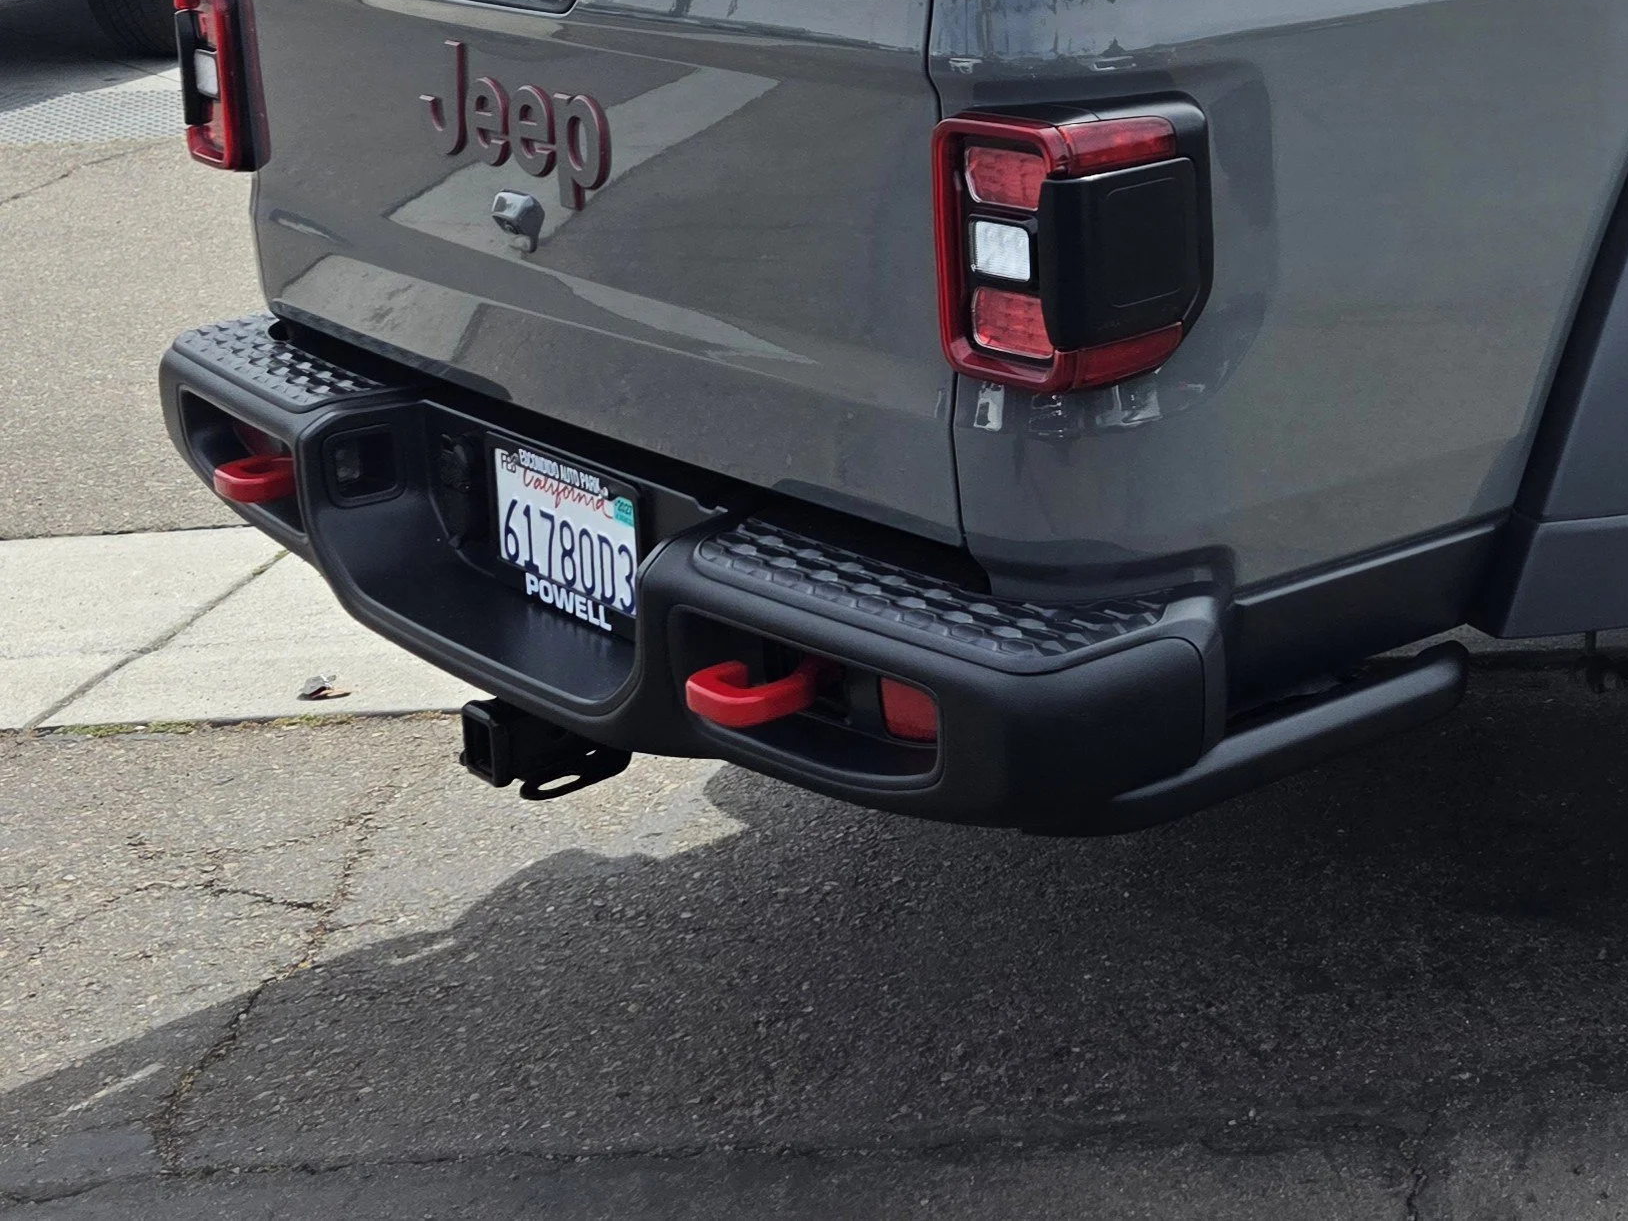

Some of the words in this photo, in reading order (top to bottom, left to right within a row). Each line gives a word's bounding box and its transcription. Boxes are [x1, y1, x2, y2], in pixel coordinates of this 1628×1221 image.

[418, 39, 612, 212] Jeep
[523, 466, 613, 519] California
[504, 499, 636, 614] 61780D3
[525, 572, 612, 631] POWELL
